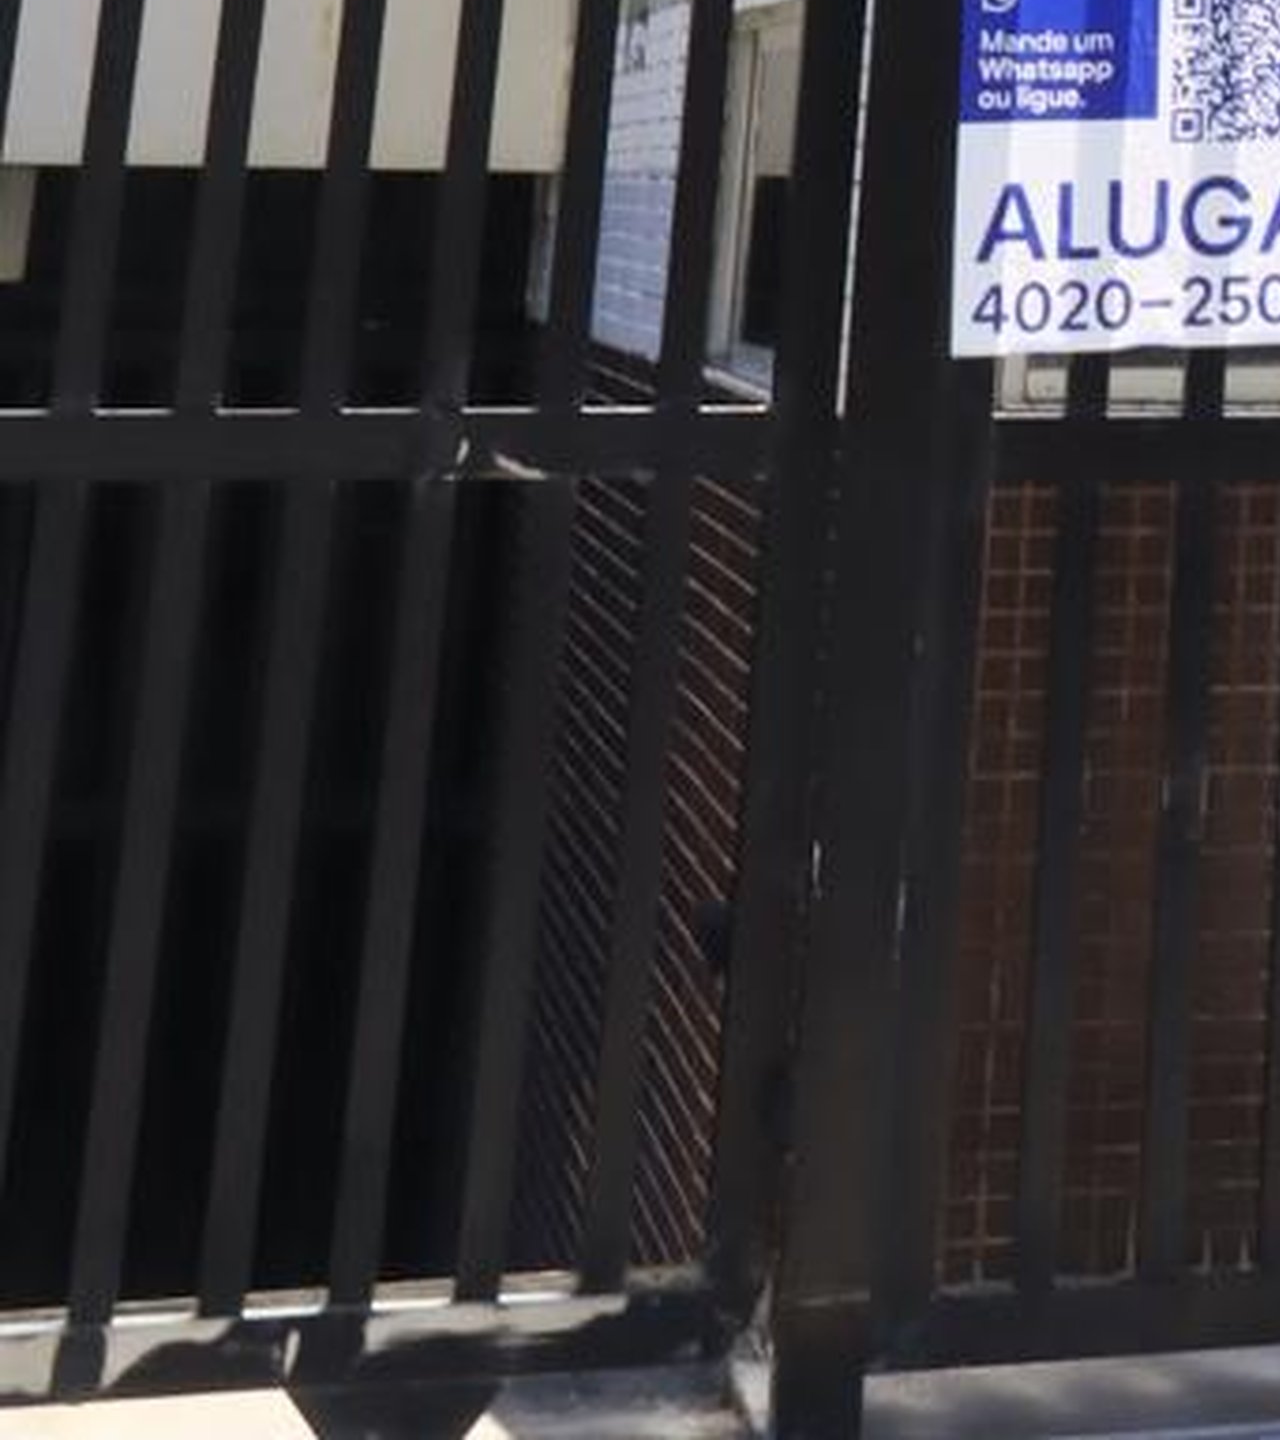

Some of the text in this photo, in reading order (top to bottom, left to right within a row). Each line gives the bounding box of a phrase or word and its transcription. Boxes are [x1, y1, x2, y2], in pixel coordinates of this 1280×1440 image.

[980, 30, 1115, 53] Mande um
[978, 58, 1114, 85] Whatsapp
[977, 85, 1087, 115] ou ligue.
